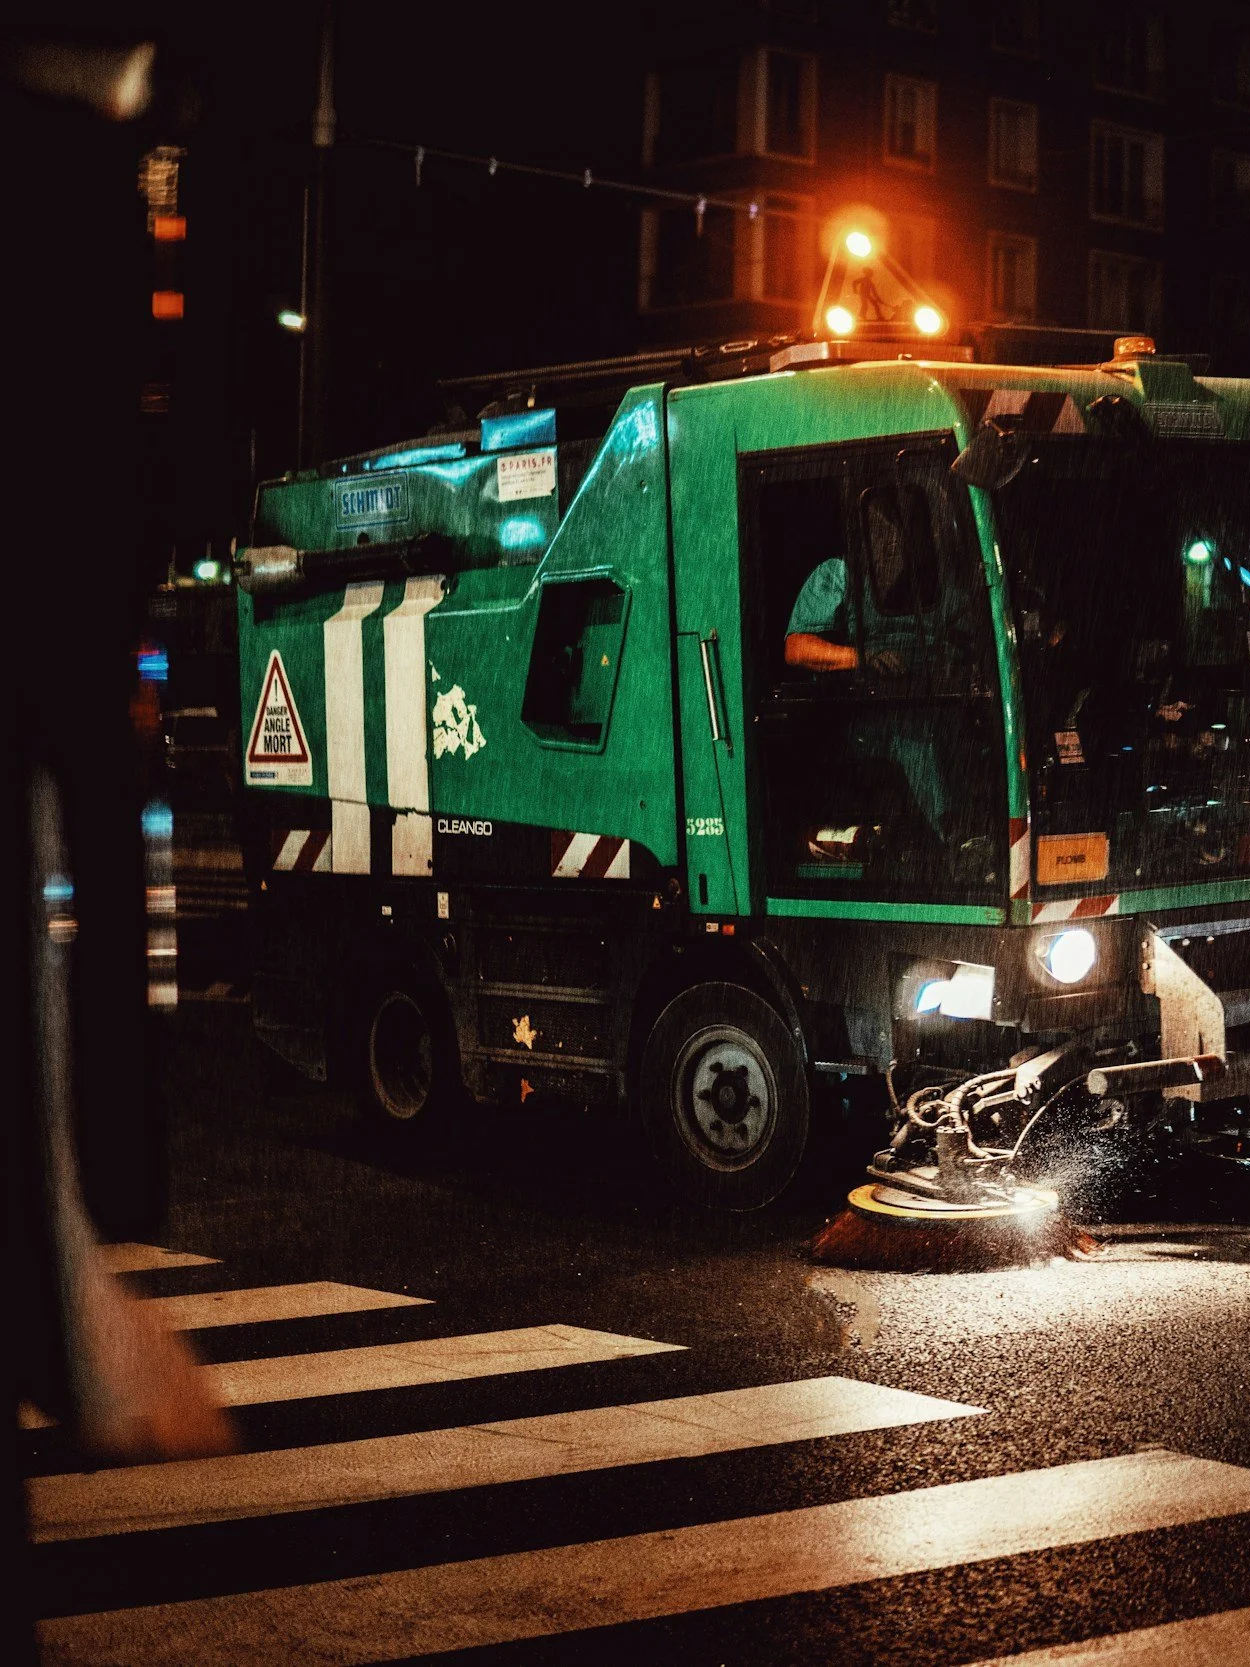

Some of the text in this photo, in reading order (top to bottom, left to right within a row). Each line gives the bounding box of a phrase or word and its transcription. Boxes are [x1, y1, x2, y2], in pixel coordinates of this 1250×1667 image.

[342, 486, 401, 515] SCHMIDT
[266, 706, 288, 716] DANGER
[264, 718, 290, 733] ANGLE
[264, 735, 292, 753] MORT
[437, 818, 493, 836] CLEANGO
[686, 817, 724, 836] 5285
